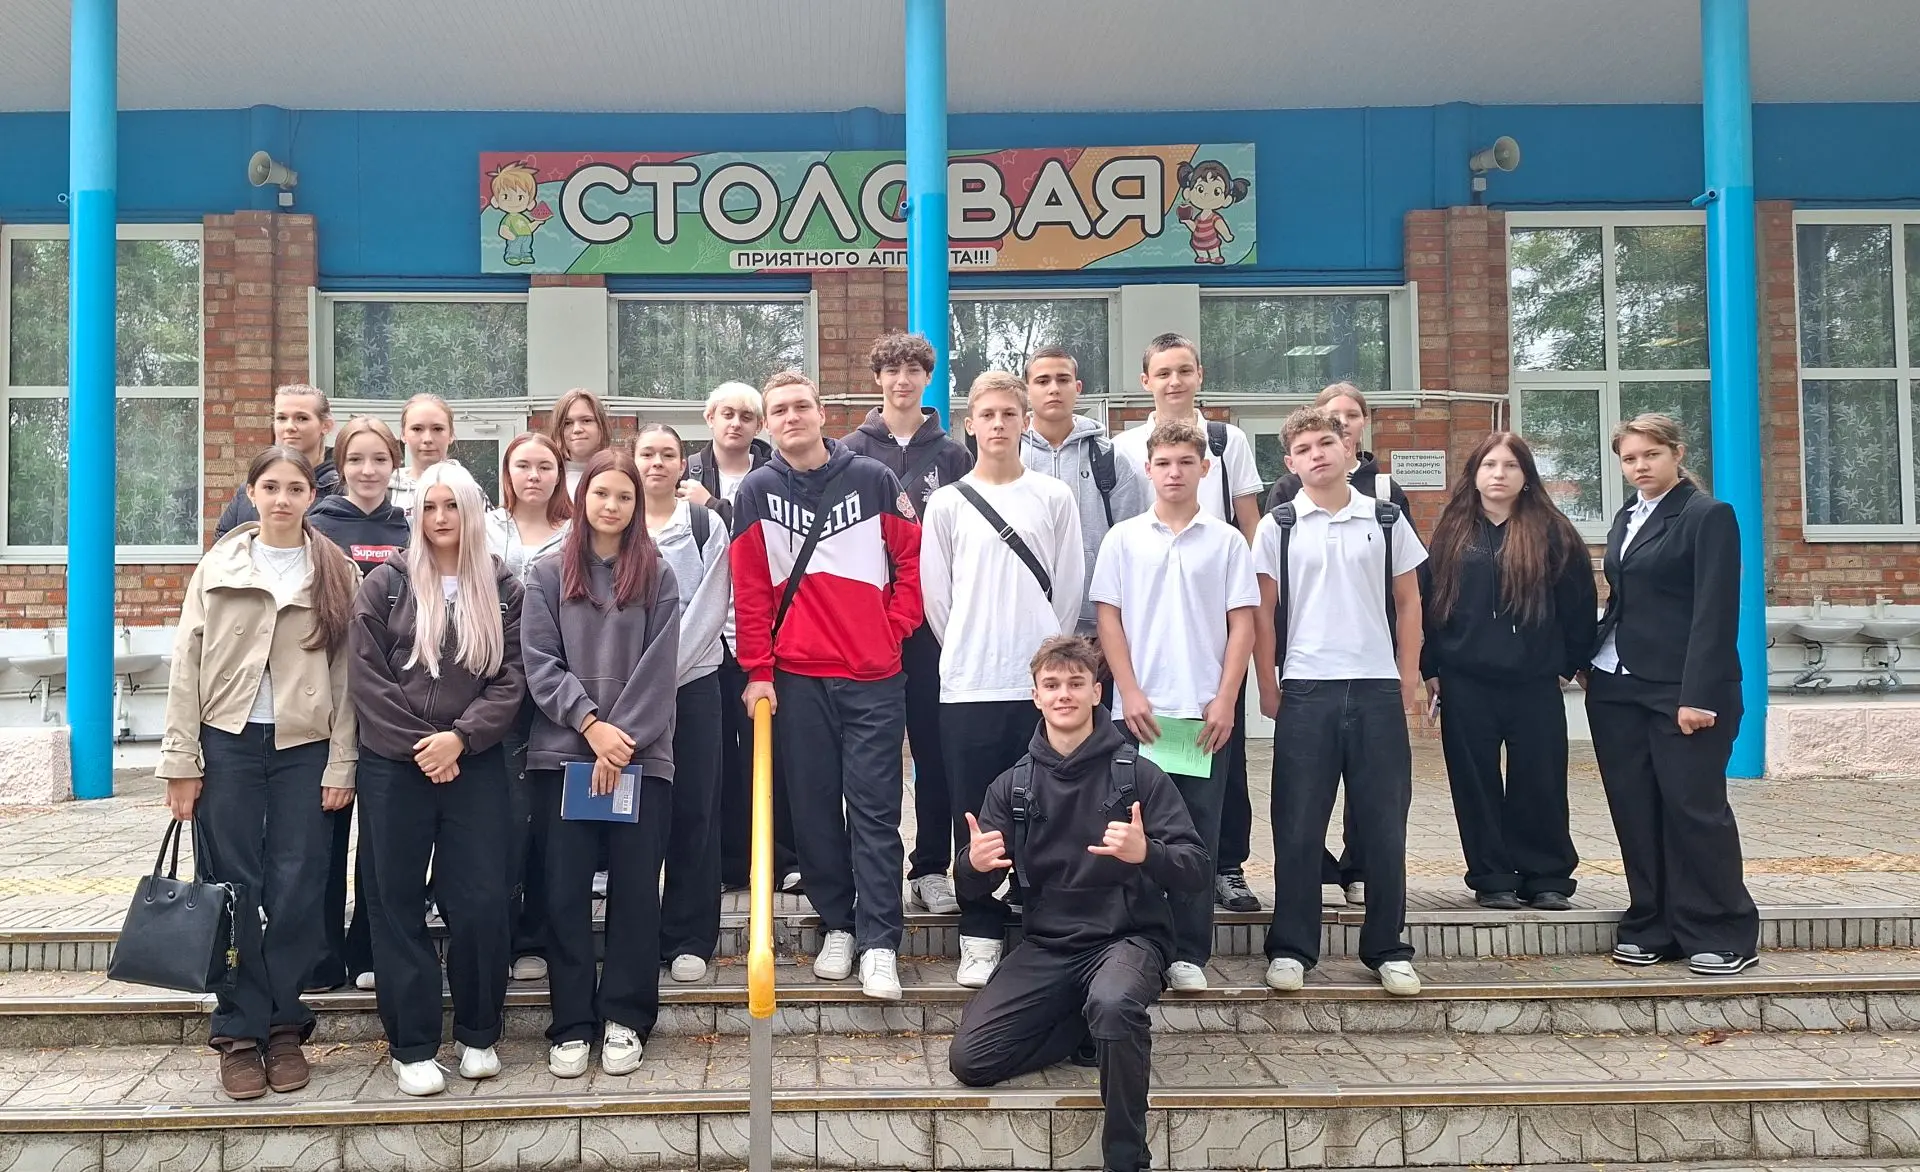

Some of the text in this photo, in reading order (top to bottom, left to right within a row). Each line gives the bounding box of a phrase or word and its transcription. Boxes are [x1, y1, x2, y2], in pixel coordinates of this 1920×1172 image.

[560, 156, 1165, 244] СТОЛОВАЯ
[737, 250, 990, 267] ПРИЯТНОГО АППТА!!!
[354, 547, 392, 560] Suprem
